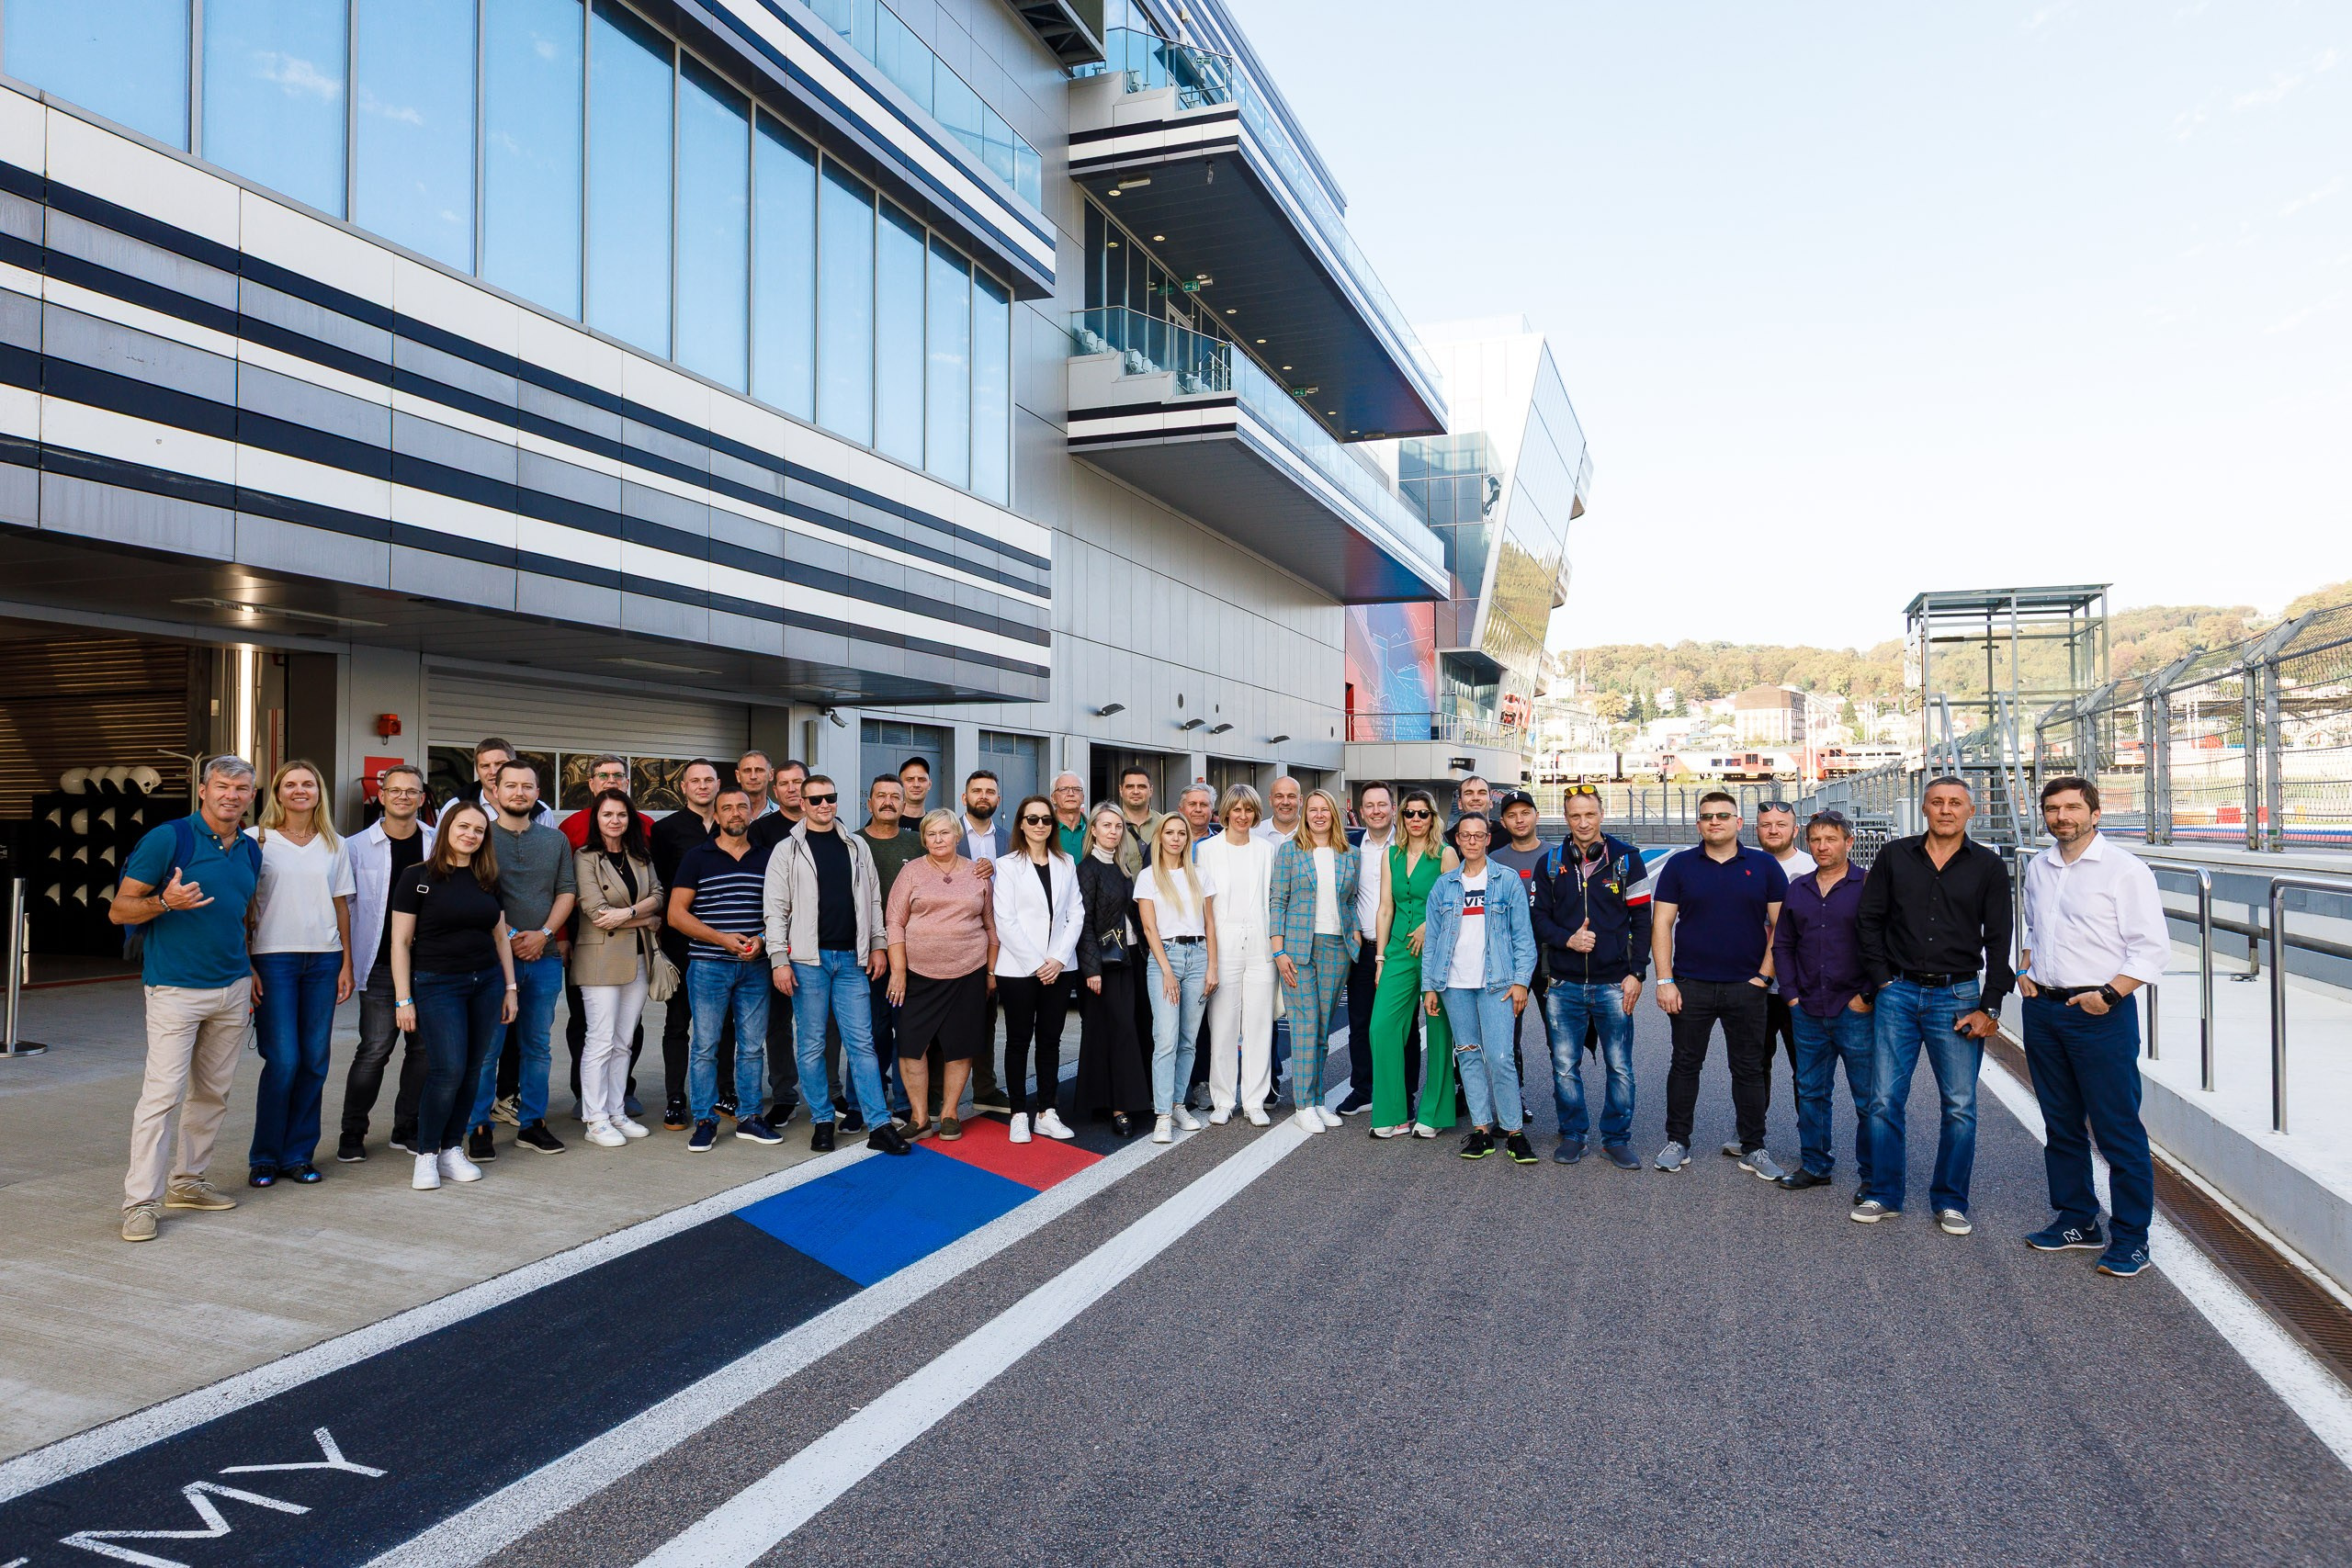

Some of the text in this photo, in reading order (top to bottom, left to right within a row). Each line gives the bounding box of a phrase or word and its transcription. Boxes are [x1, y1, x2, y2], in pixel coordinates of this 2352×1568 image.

[1464, 897, 1485, 907] VI'S
[2063, 1228, 2083, 1243] N
[2132, 1249, 2146, 1265] N
[2, 1427, 388, 1568] MY
